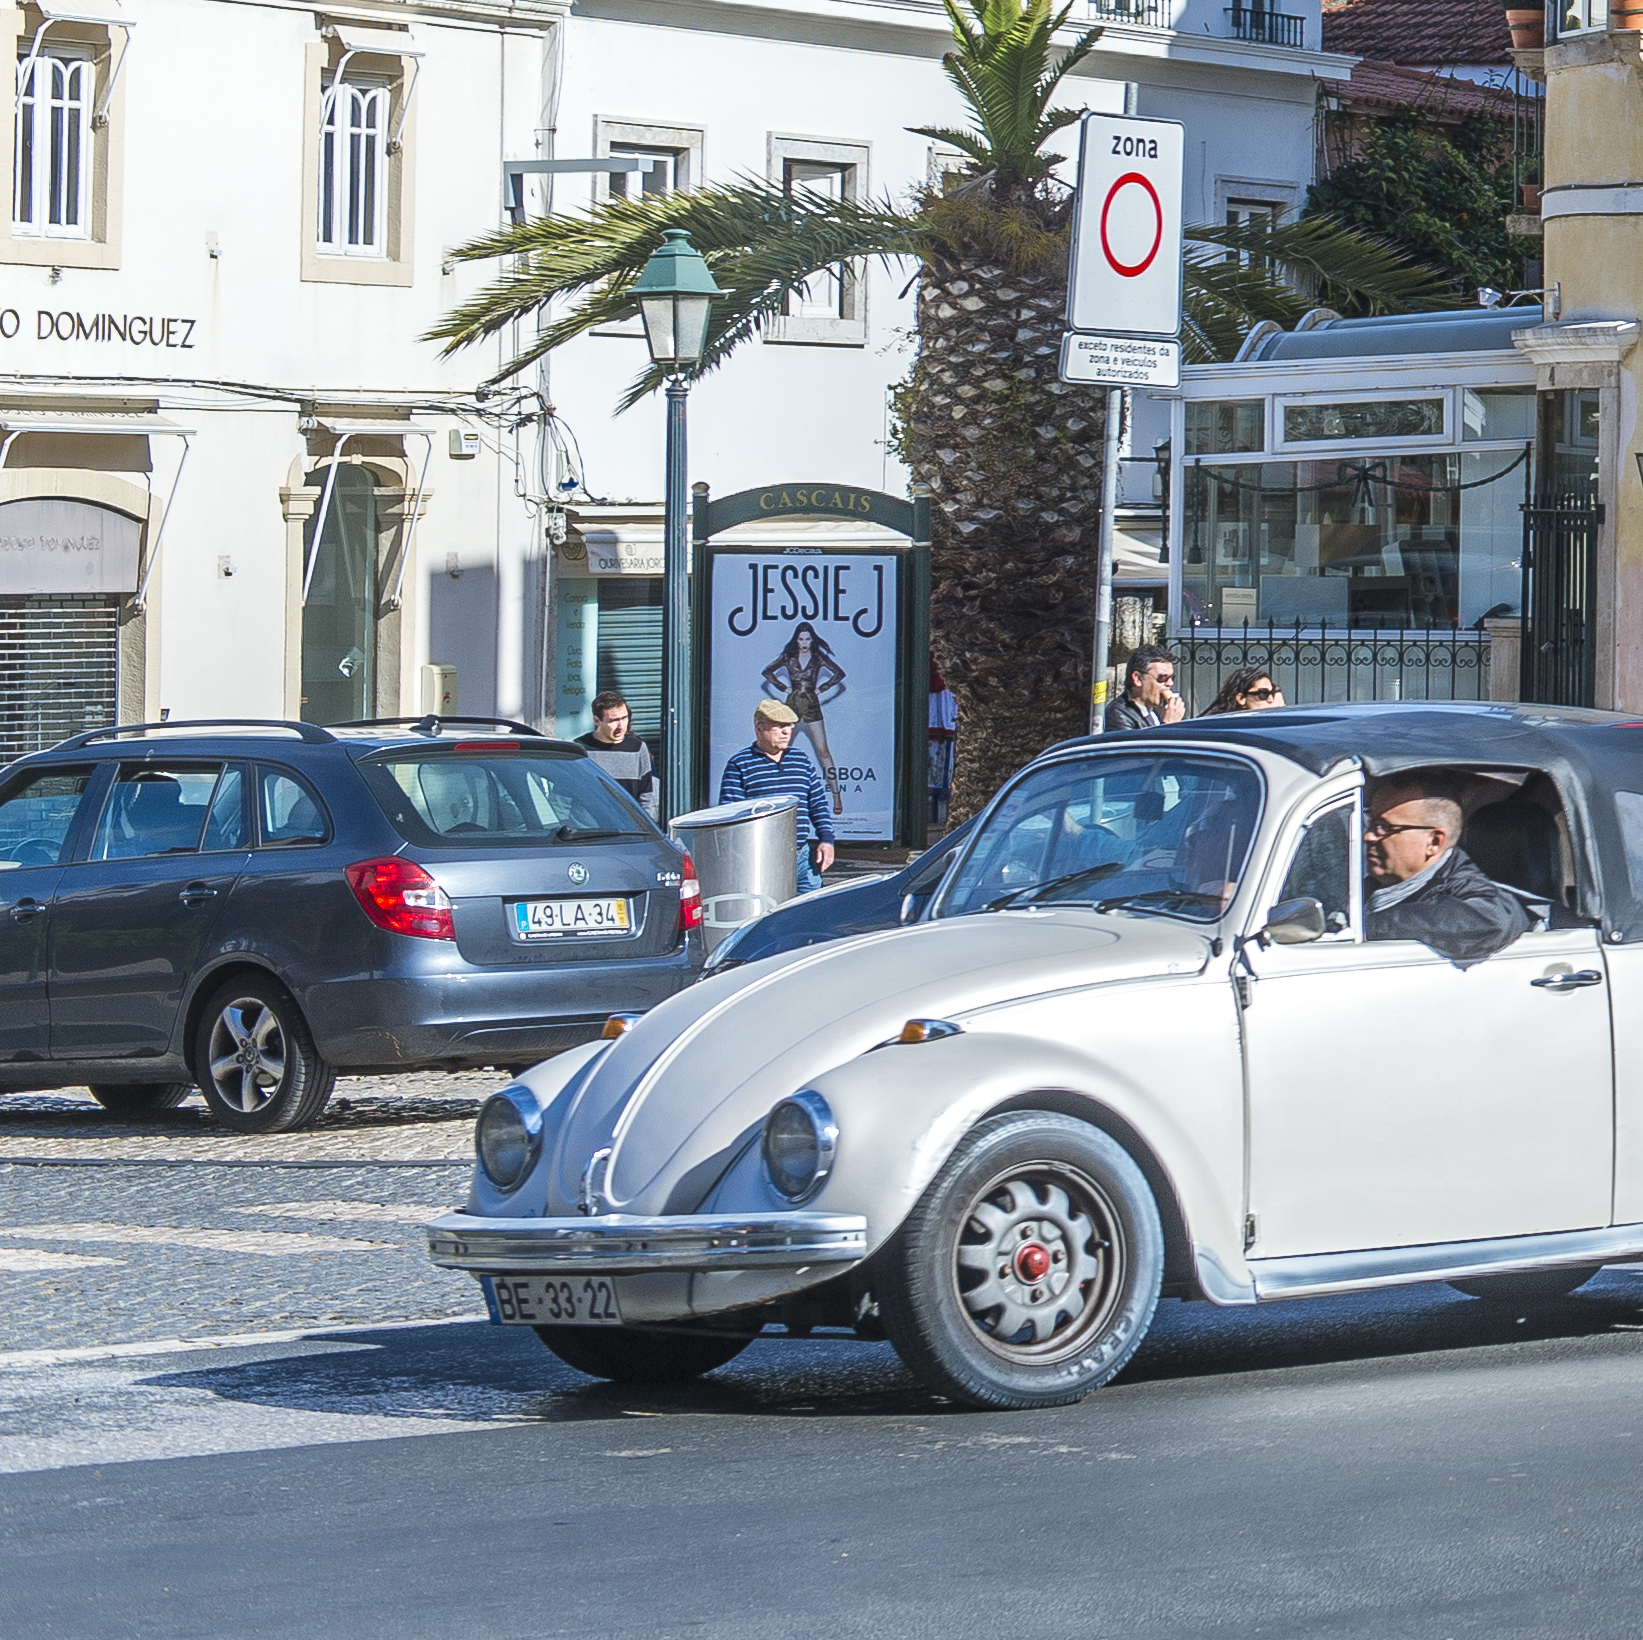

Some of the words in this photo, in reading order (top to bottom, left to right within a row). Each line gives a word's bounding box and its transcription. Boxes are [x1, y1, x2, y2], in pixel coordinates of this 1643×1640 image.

[1111, 134, 1159, 159] zona
[37, 310, 197, 349] DOMINGUEZ
[1078, 340, 1107, 351] exceto
[1110, 342, 1157, 357] residentes
[1159, 345, 1171, 357] da
[1089, 354, 1110, 364] zona
[1096, 367, 1150, 381] autorizados
[759, 489, 873, 512] CASCAIS
[727, 562, 851, 637] JESSIE
[851, 564, 884, 638] J
